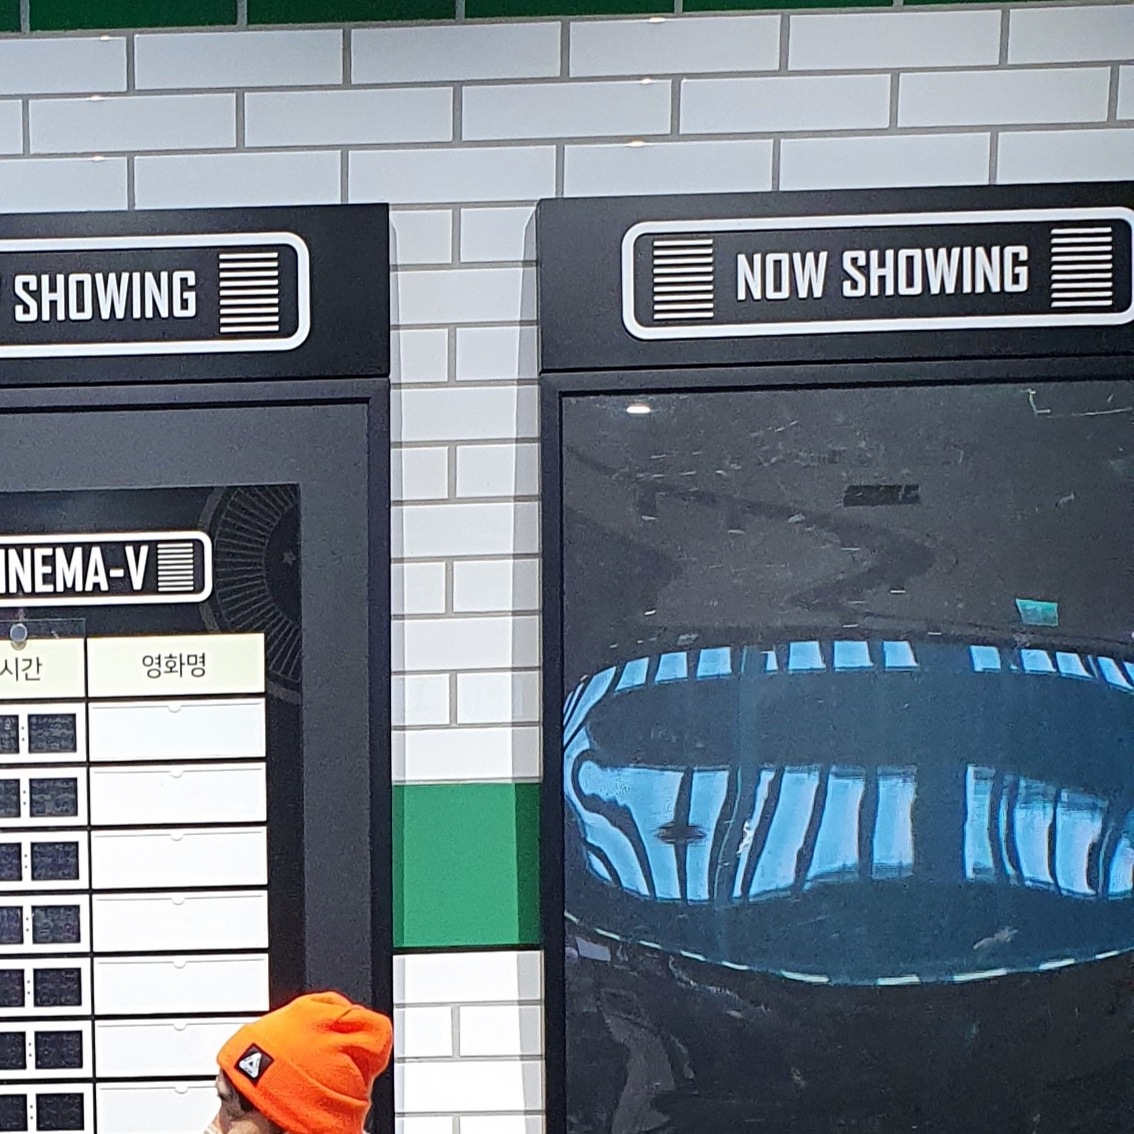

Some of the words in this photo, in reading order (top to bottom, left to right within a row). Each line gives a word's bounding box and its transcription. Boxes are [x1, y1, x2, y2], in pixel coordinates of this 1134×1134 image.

[736, 251, 828, 301] NOW
[842, 245, 1028, 297] SHOWING
[14, 270, 196, 322] SHOWING
[0, 656, 44, 682] 시간
[141, 652, 208, 679] 영화명
